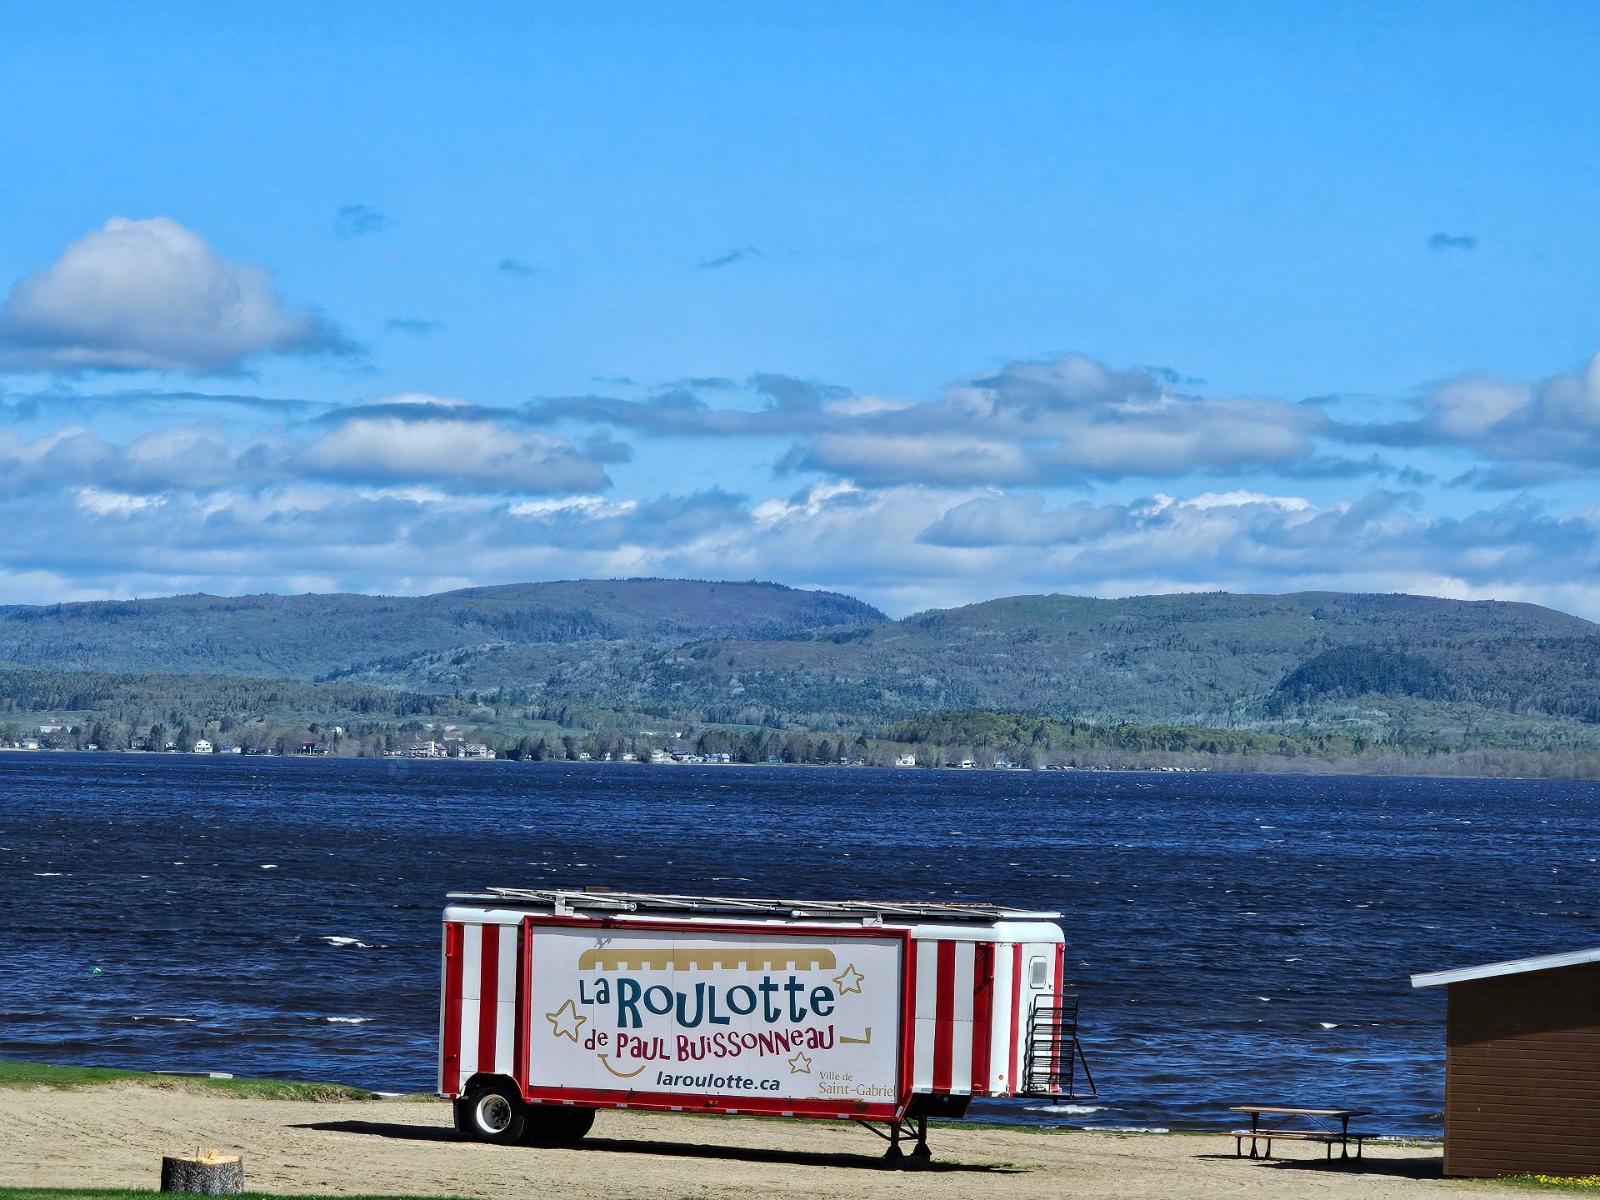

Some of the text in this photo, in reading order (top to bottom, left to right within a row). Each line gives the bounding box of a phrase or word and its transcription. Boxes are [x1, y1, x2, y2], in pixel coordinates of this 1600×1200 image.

[584, 1028, 608, 1051] de
[656, 1071, 781, 1091] laroulotte.ca
[819, 1071, 853, 1082] Ville de
[818, 1081, 897, 1098] Saint-Gabriel
